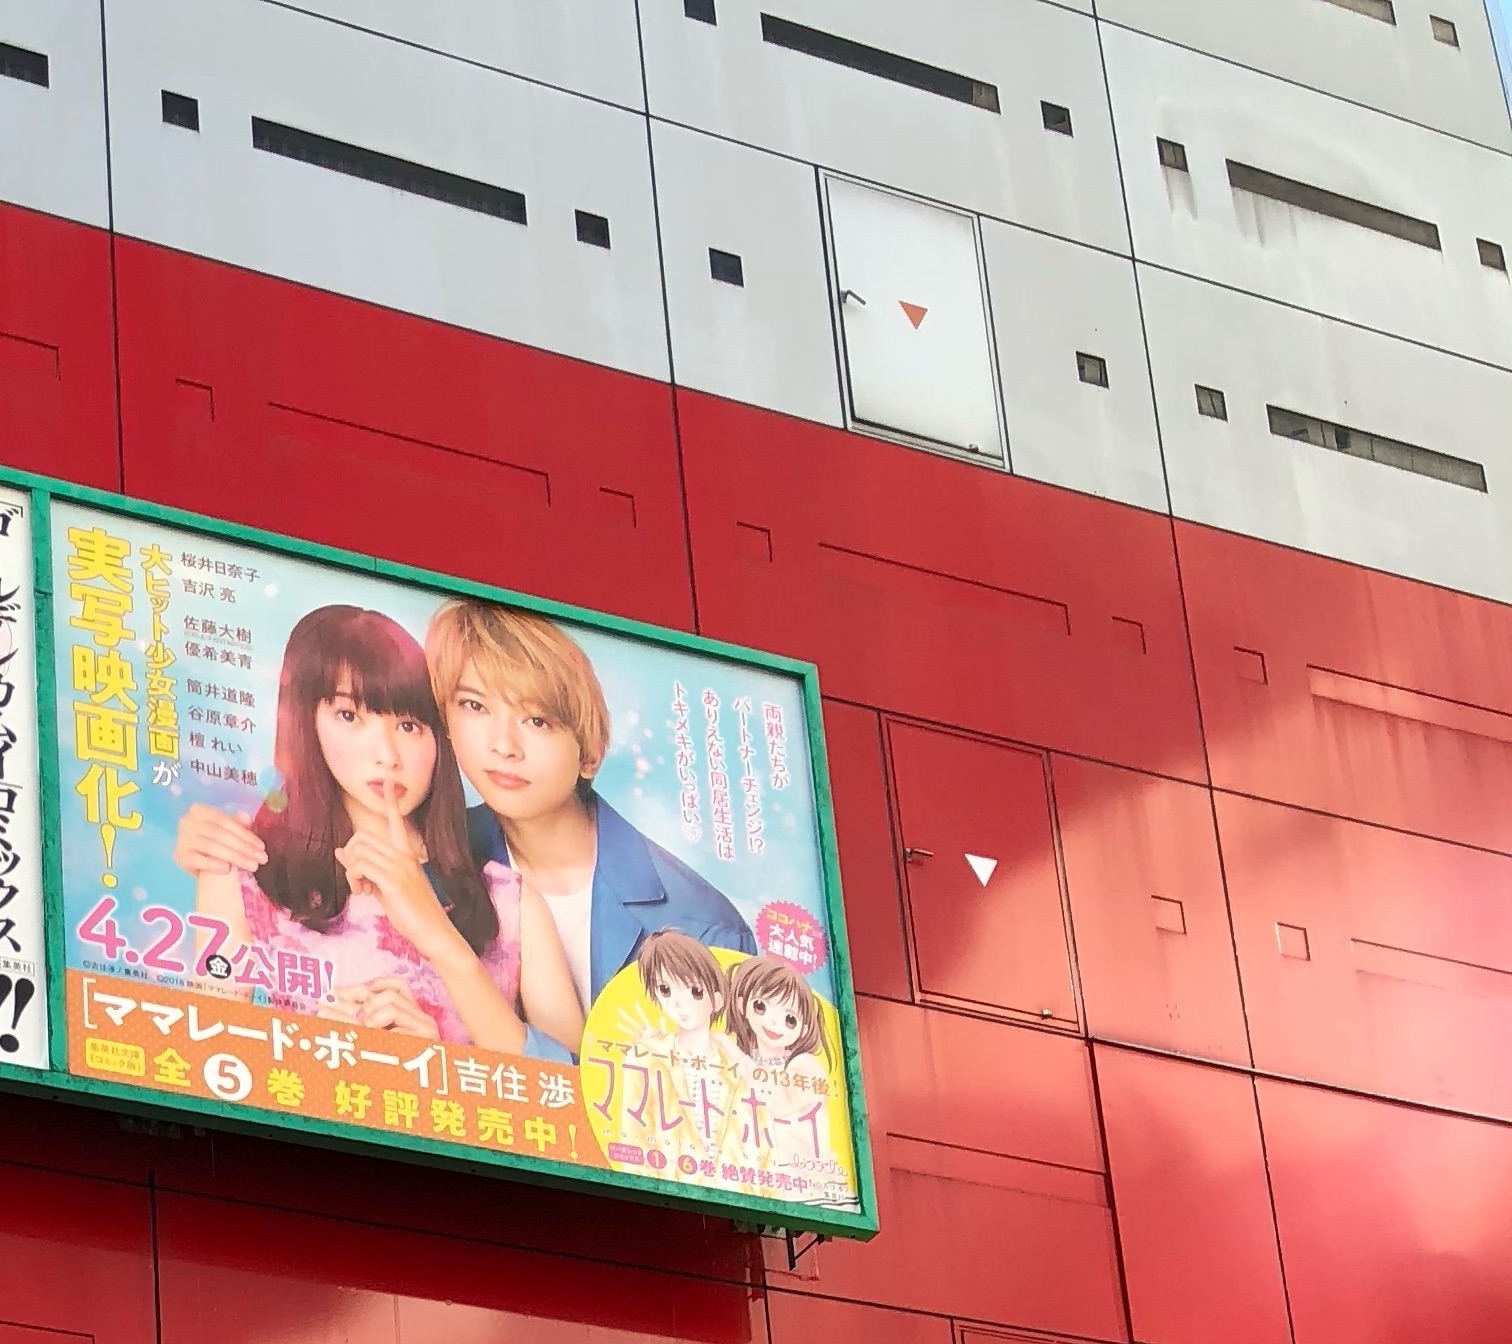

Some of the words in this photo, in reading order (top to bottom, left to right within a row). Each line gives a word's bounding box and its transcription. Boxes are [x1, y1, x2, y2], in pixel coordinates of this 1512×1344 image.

[180, 551, 261, 583] 桜井日奈子
[181, 578, 215, 598] 吉沢
[183, 615, 252, 644] 佐藤大樹
[139, 543, 181, 787] 大ヒット少女漫画が
[185, 641, 252, 670] 優希美青
[66, 526, 143, 889] 実写映画化!
[188, 705, 257, 735] 谷原章介
[211, 737, 243, 755] れい
[764, 704, 788, 790] 両親たちが
[190, 758, 258, 787] 中山美穂
[703, 689, 734, 860] ありえない同居生活は
[2, 957, 34, 974] 集英社
[597, 1039, 740, 1079] ママレード・ボーイ
[454, 1060, 530, 1104] 吉住
[538, 1069, 576, 1110] 渉
